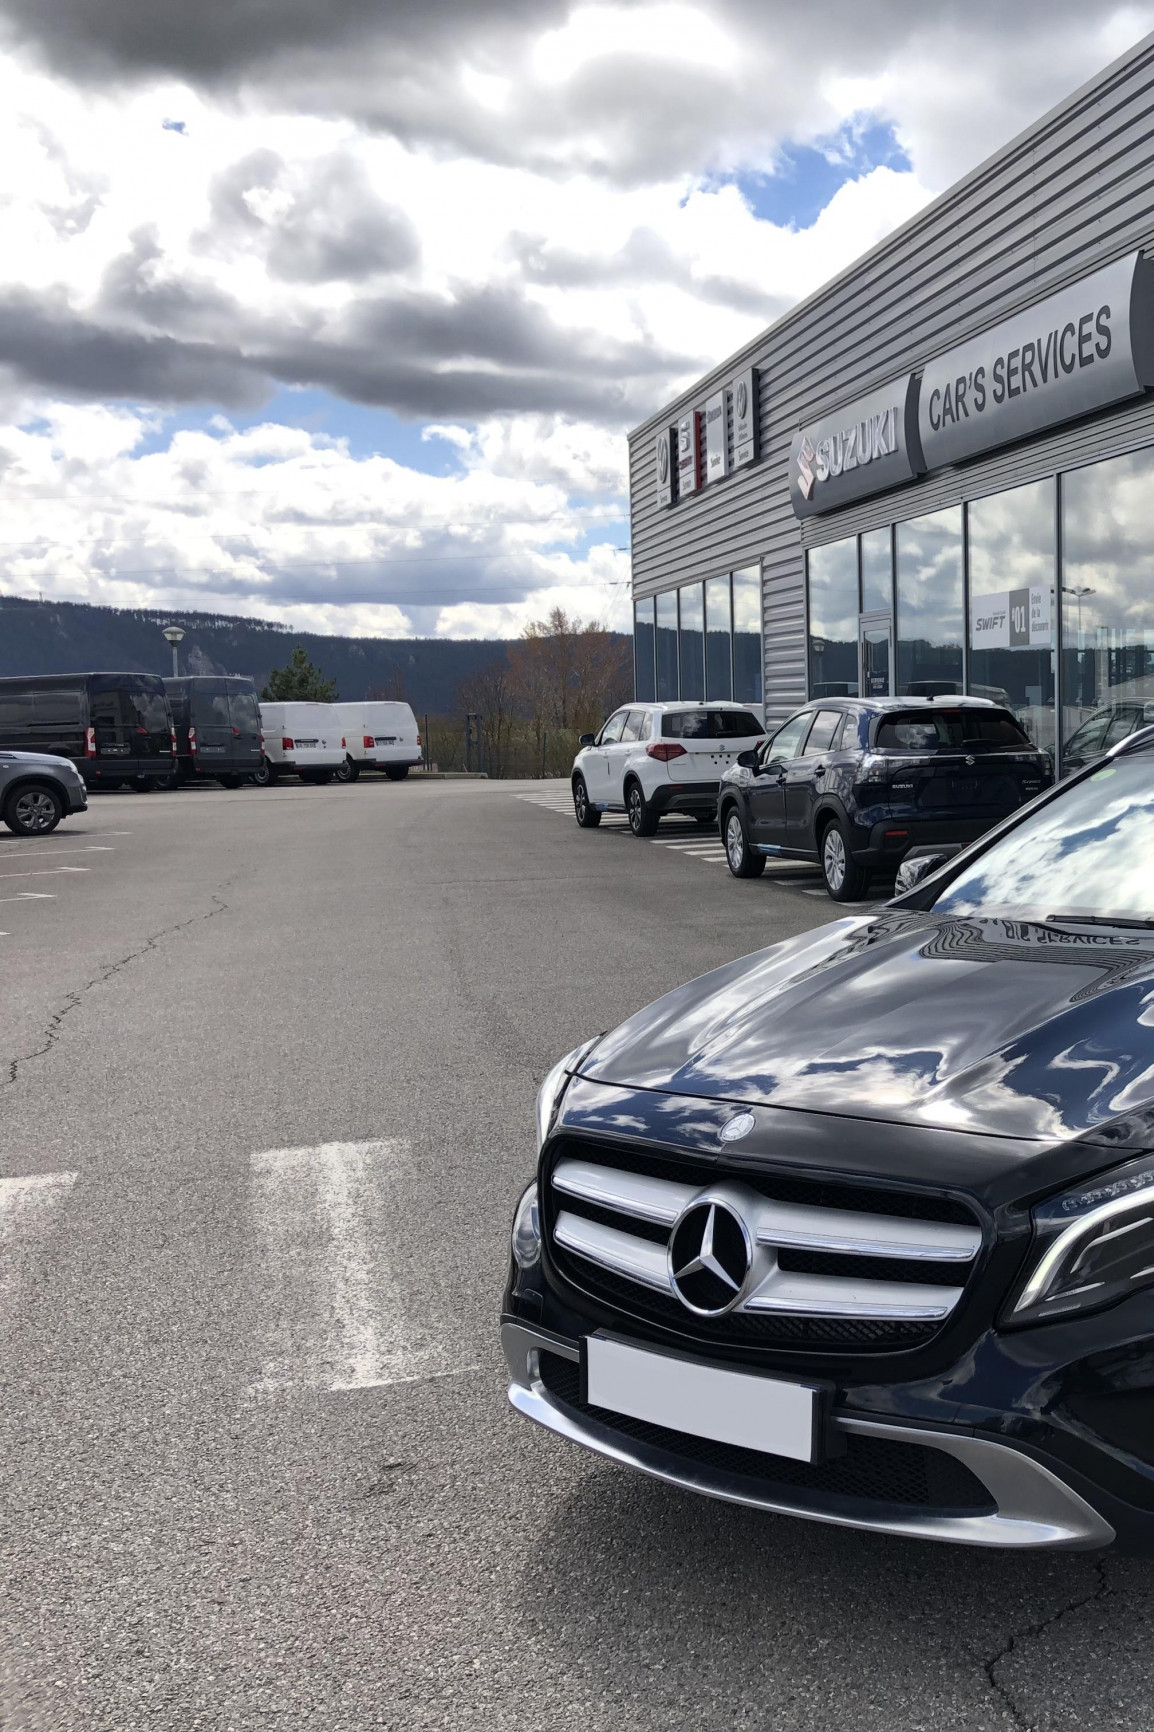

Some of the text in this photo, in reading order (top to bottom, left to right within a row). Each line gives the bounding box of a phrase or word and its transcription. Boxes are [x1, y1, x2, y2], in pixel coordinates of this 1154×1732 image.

[929, 305, 1112, 431] CAR'S SERVICES
[816, 406, 899, 482] SUZUKI
[976, 616, 1006, 631] SWIFT
